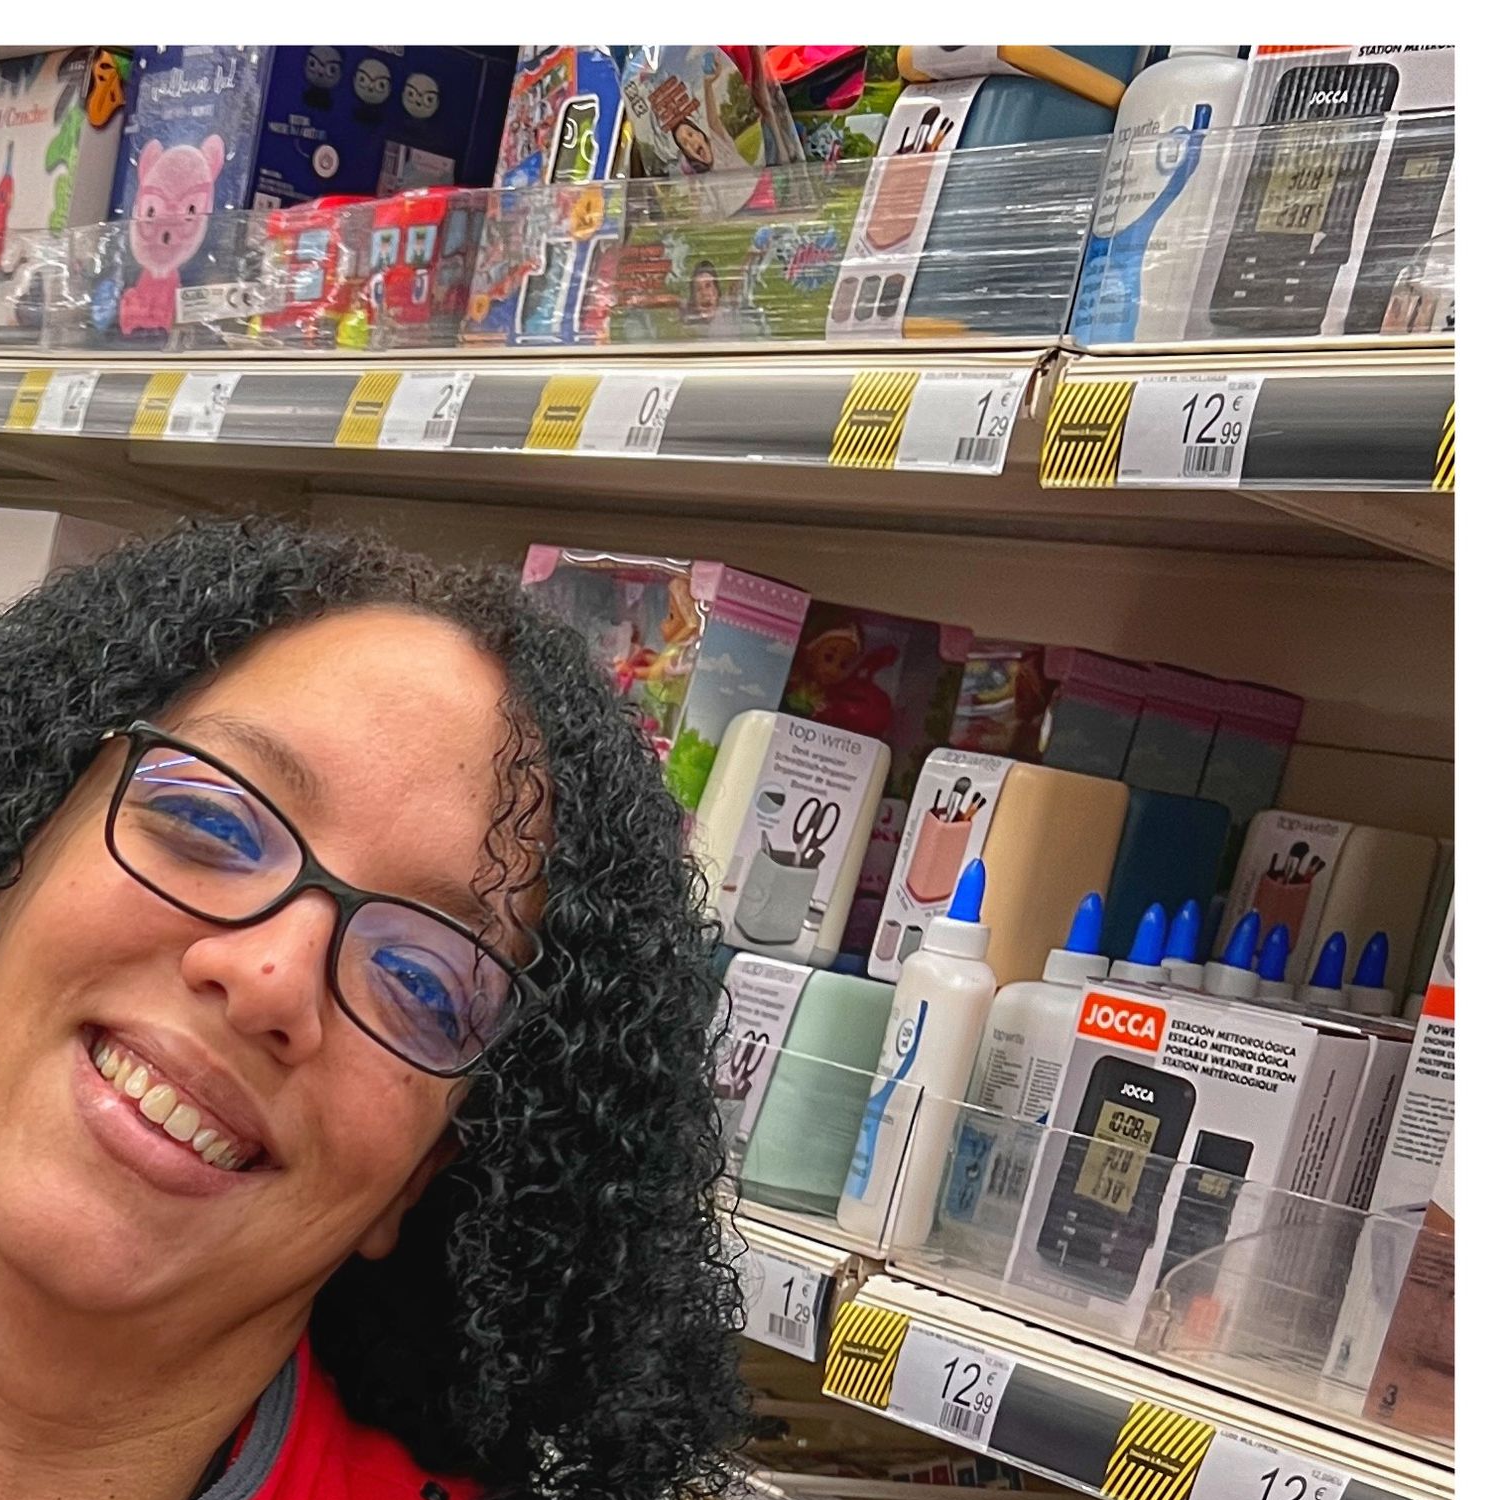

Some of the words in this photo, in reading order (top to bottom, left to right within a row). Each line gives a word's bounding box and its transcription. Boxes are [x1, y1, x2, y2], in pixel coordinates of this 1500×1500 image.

[1309, 90, 1348, 105] JOCCA
[638, 387, 659, 425] 0
[976, 390, 993, 436] 1
[1182, 393, 1225, 444] 12
[988, 416, 1009, 437] 29
[1220, 422, 1242, 444] 99
[789, 722, 816, 743] top
[821, 733, 862, 755] write
[1084, 1003, 1156, 1041] JOCCA
[1172, 1020, 1214, 1037] ESTACIÓN
[1217, 1030, 1297, 1057] METEOROLÓGICA
[1165, 1045, 1208, 1062] PORTABLE
[1211, 1054, 1253, 1073] WEATHER
[1256, 1066, 1296, 1083] STATION
[1168, 1032, 1207, 1049] ESTAÇÃO
[1211, 1042, 1289, 1069] METEOROLÓGICA
[1121, 1083, 1154, 1103] JOCCA
[1162, 1056, 1199, 1073] STATION
[1201, 1065, 1278, 1093] MÉTÉROLOGIQUE
[782, 1276, 795, 1317] 1
[794, 1303, 811, 1324] 29
[942, 1357, 981, 1407] 12
[974, 1391, 993, 1414] 99
